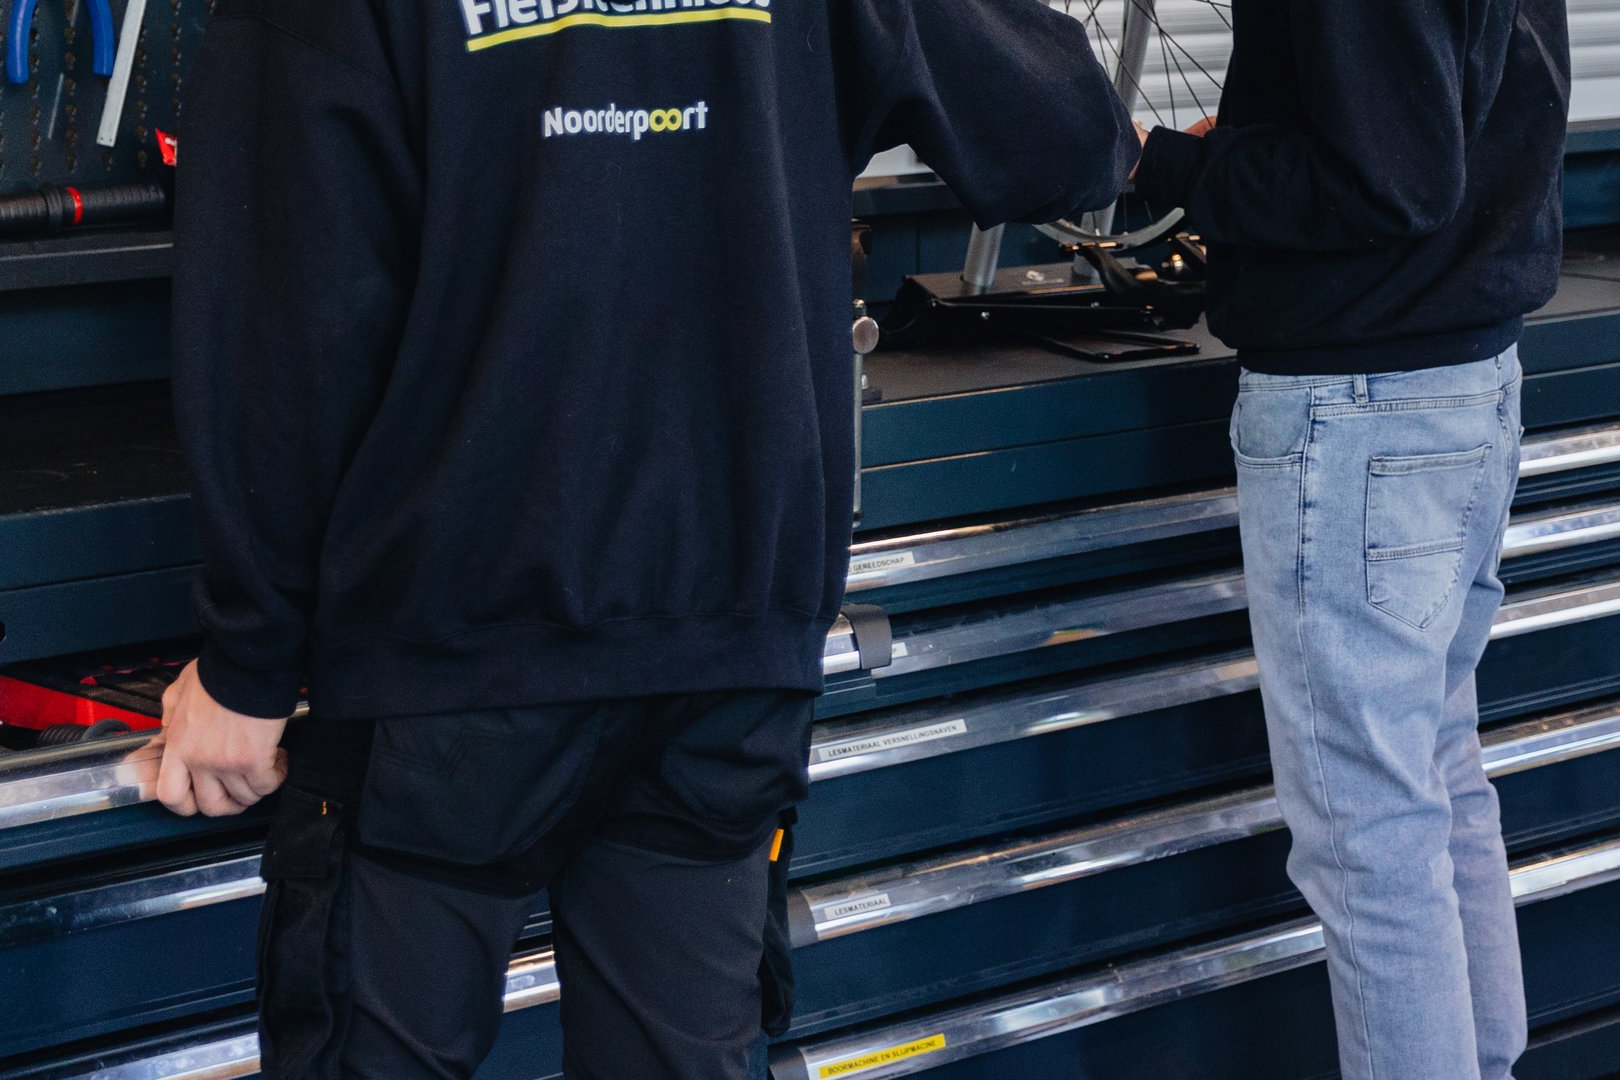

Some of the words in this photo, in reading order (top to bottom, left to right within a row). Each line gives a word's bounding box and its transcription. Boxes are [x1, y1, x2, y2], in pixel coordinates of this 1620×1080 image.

[542, 100, 709, 141] Noorderpoort
[852, 557, 904, 572] GEREEDSCHAP
[827, 742, 881, 757] LESMATERIAAL
[883, 724, 958, 746] VERSNELLINGSNAVEN
[834, 897, 888, 916] LESMATERIAAL
[827, 1055, 879, 1075] BOORMACHINE
[881, 1052, 891, 1062] EN
